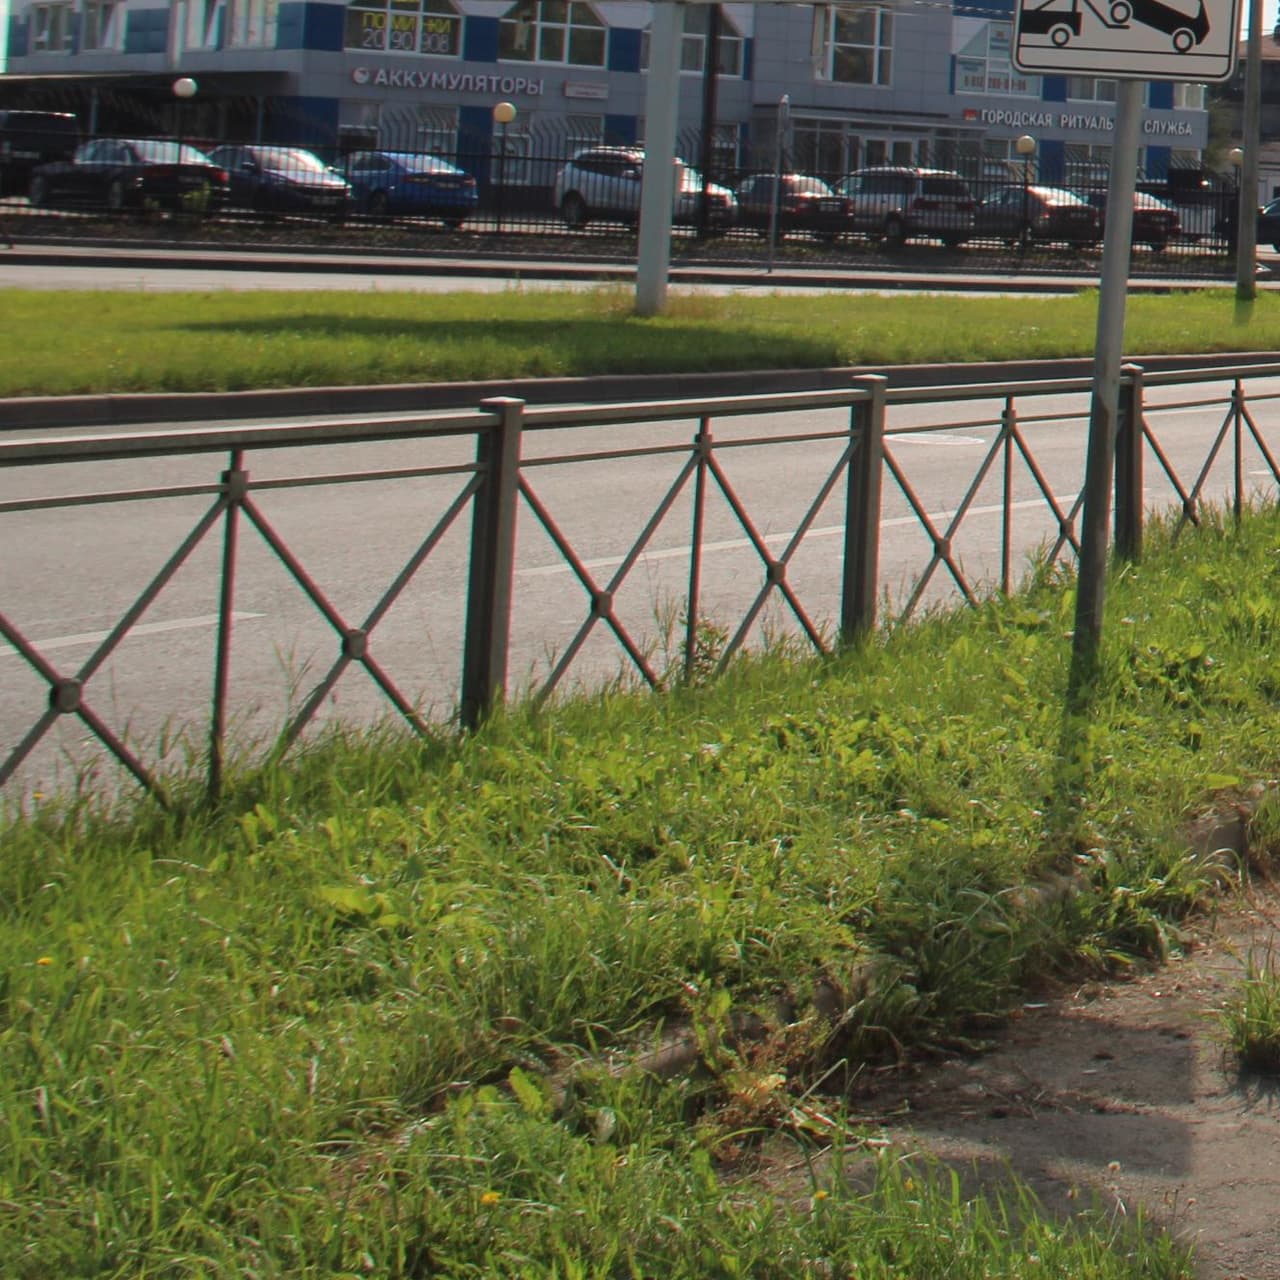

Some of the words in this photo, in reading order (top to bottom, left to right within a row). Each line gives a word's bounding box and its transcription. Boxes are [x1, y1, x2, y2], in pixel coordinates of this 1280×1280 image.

[374, 68, 545, 96] АККУМУЛЯТОРЫ
[981, 108, 1053, 128] ГОРОДСКАЯ
[1060, 113, 1114, 131] РИТУАЛЬ
[1143, 119, 1193, 136] СЛУЖБА
